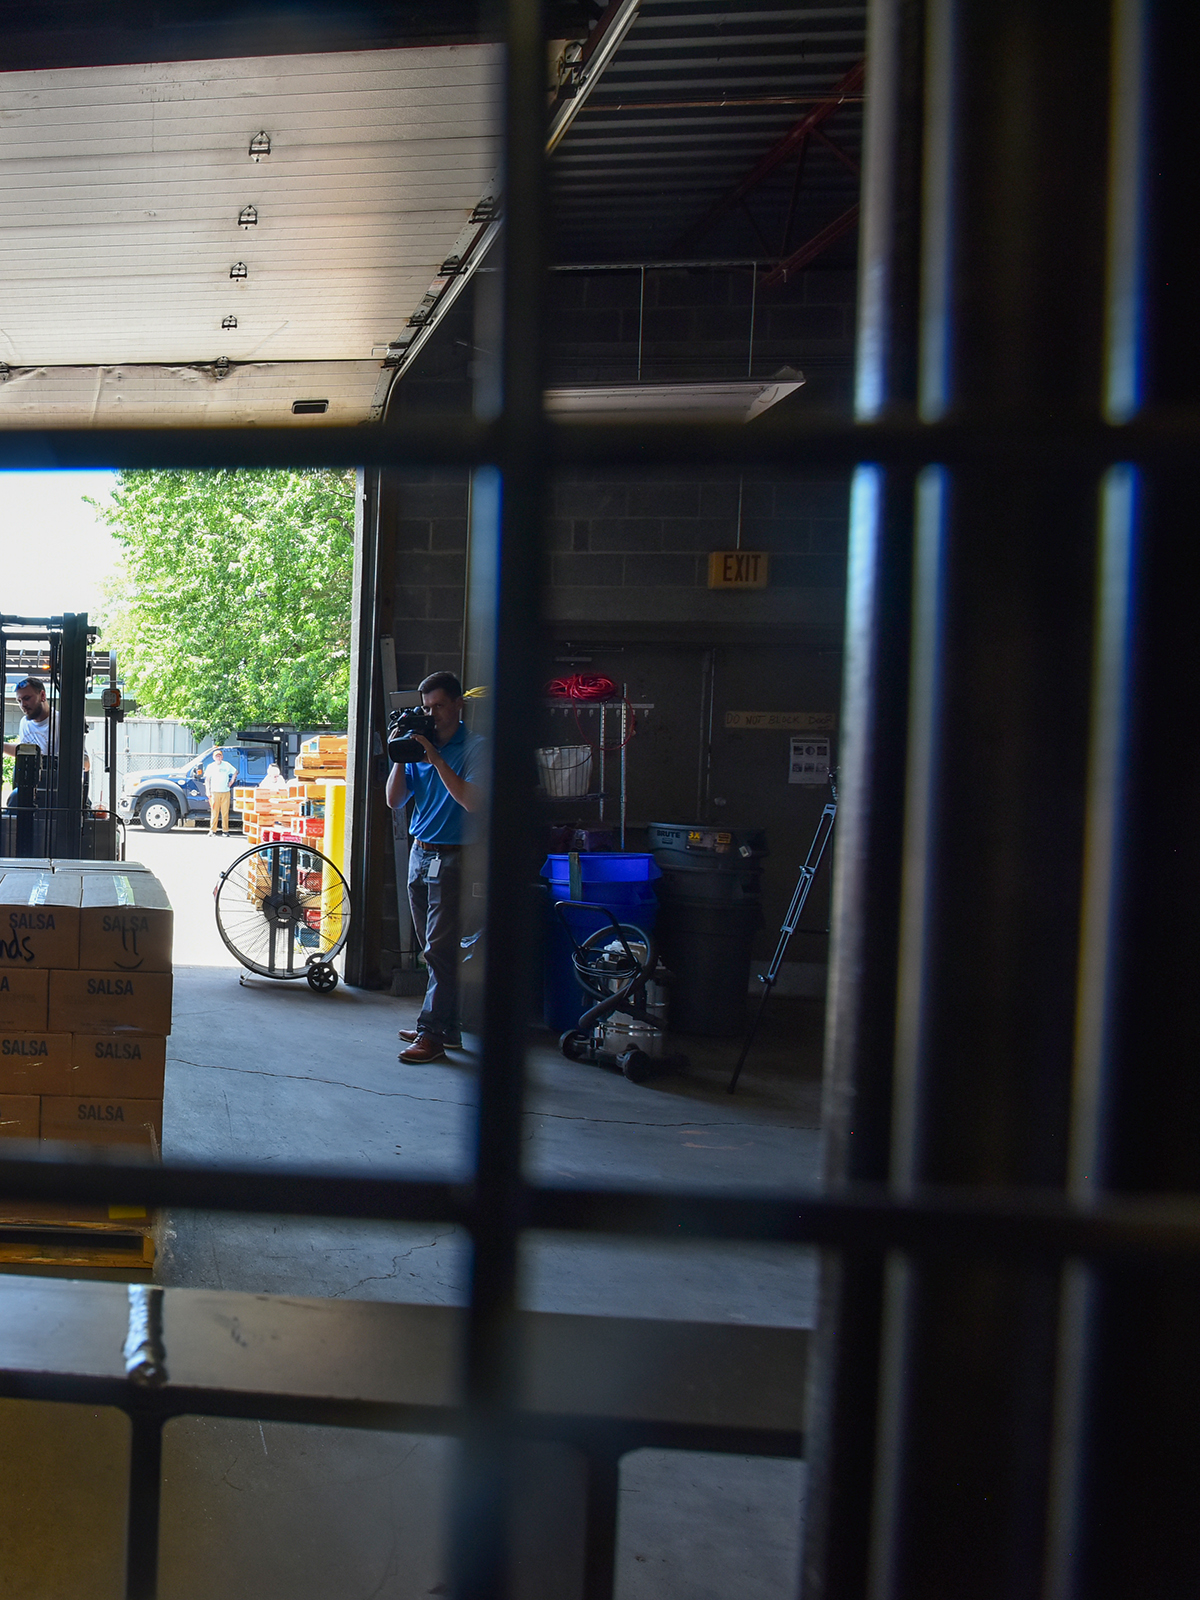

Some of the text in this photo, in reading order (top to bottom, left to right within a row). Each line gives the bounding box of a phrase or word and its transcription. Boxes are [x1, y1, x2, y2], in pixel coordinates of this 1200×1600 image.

[723, 554, 762, 583] EXIT
[726, 713, 740, 725] DO
[745, 715, 765, 725] NOT
[768, 715, 799, 725] BLOCK
[656, 829, 681, 839] BRUTE
[9, 912, 56, 930] SALSA
[102, 915, 149, 932] SALSA
[87, 978, 134, 996] SALSA
[1, 1039, 48, 1057] SALSA
[94, 1042, 142, 1060] SALSA
[78, 1104, 124, 1122] SALSA
